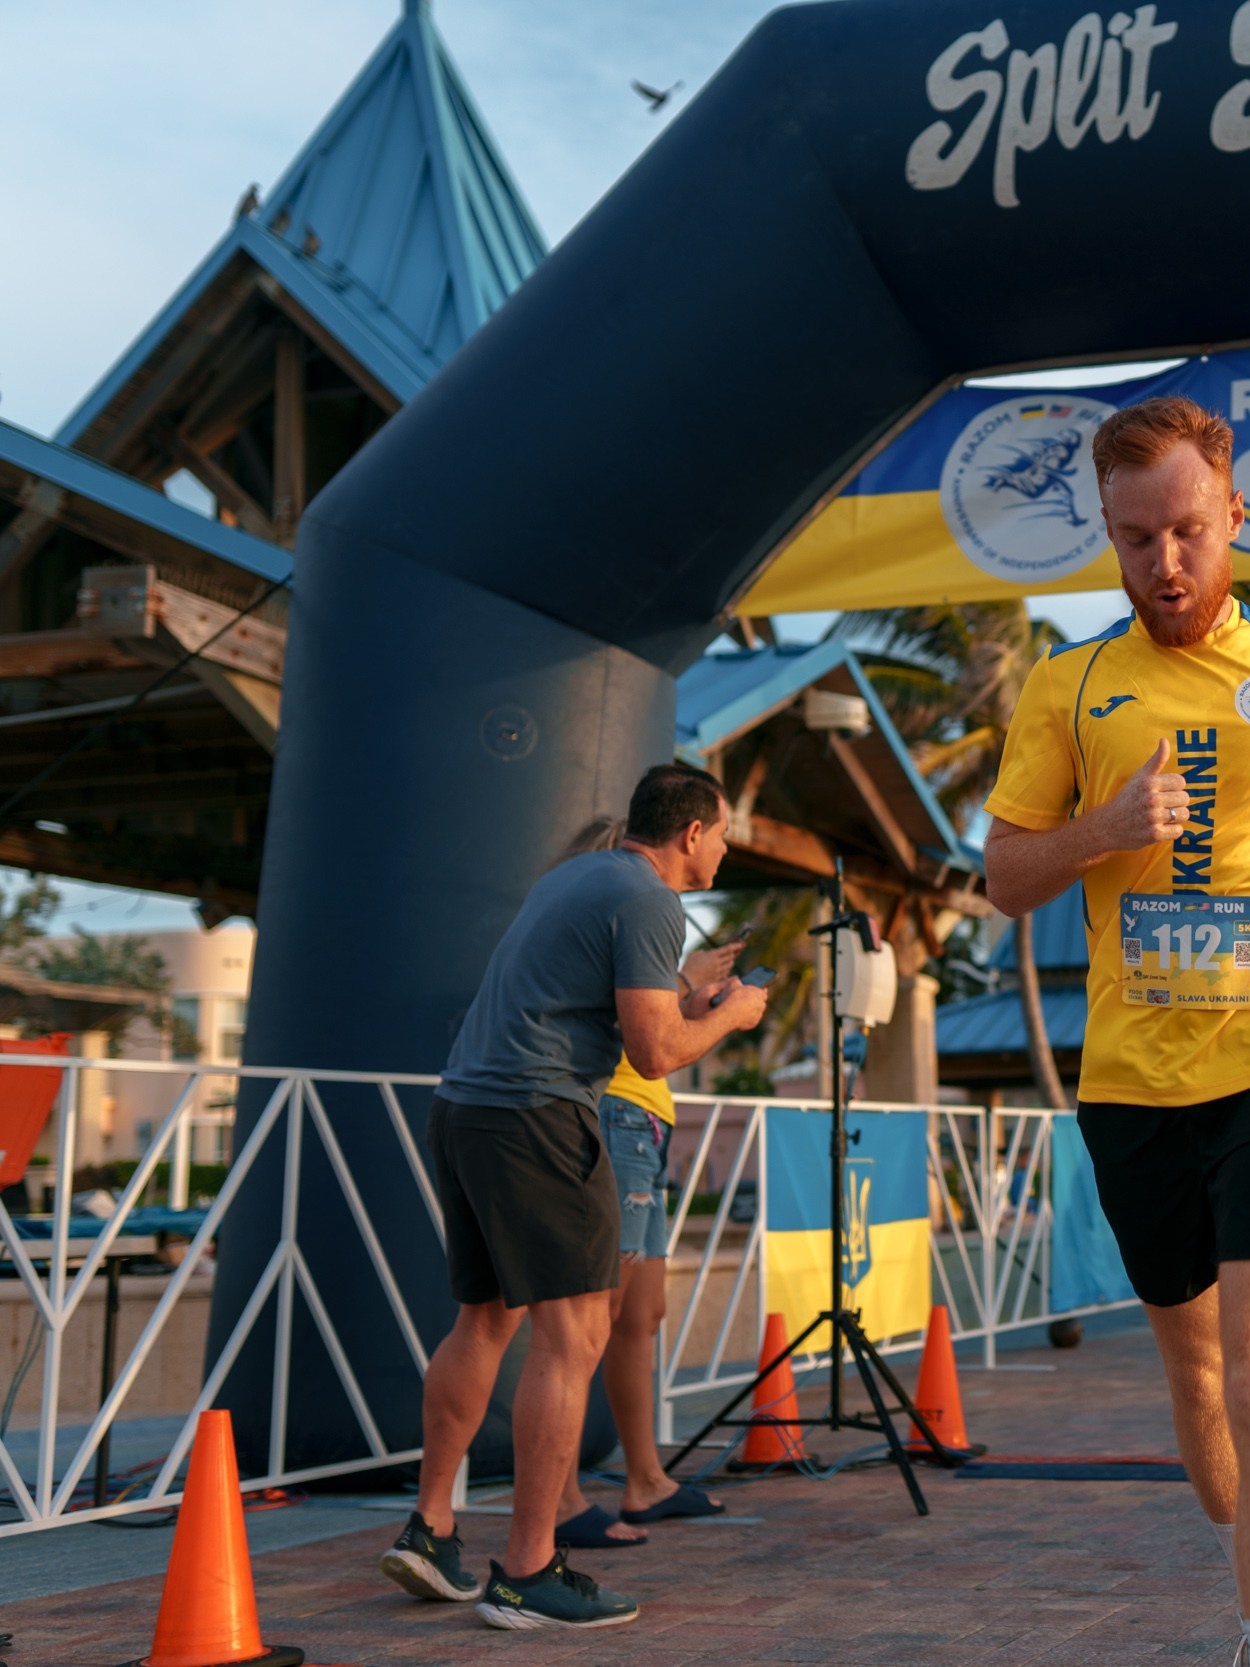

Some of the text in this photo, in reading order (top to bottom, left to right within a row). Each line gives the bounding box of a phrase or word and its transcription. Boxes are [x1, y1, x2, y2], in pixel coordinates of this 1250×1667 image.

[906, 4, 1178, 207] Split
[960, 412, 1013, 465] RAZOM
[1171, 727, 1218, 896] KRAINE
[1131, 900, 1245, 914] RAZOM RUN
[1151, 923, 1222, 971] 112
[1176, 994, 1206, 1003] SLAVA
